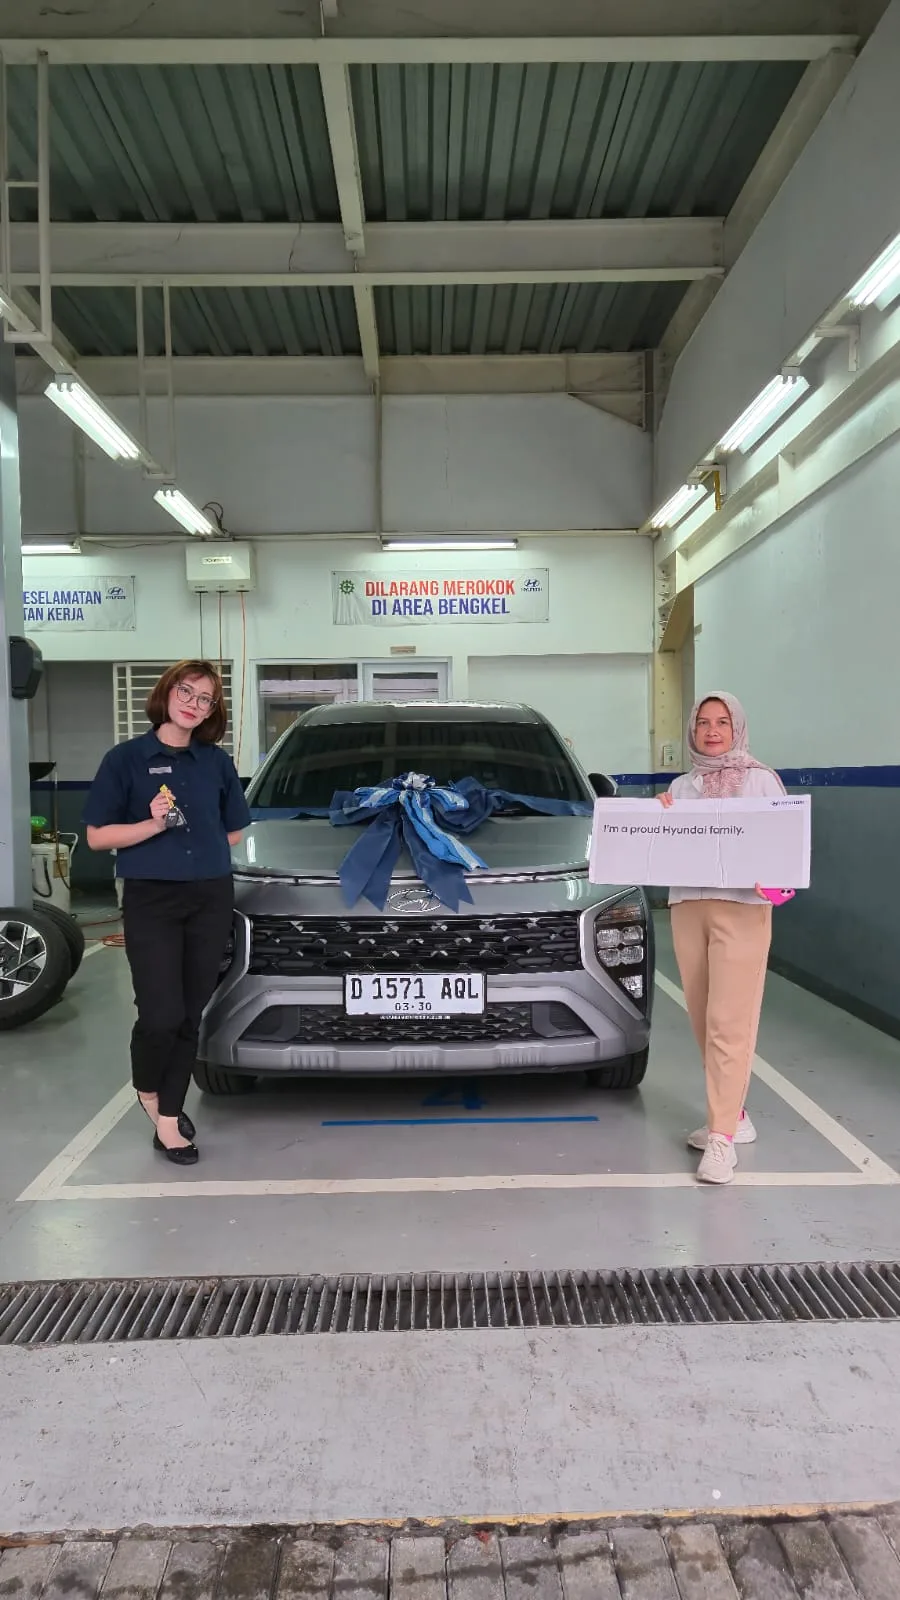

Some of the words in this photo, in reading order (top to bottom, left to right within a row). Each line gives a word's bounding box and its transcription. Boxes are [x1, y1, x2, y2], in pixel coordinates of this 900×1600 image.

[365, 580, 439, 597] DILARANG
[443, 579, 516, 596] MEROKOK
[47, 607, 85, 621] KERJA
[371, 598, 387, 616] DI
[392, 598, 434, 616] AREA
[438, 598, 510, 615] BENGKEL
[603, 824, 619, 833] I'm
[630, 825, 660, 836] proud
[662, 825, 707, 836] Hyundai
[709, 825, 744, 837] family.
[350, 977, 363, 1000] D
[372, 977, 426, 1000] 1571
[440, 977, 479, 1000] AQL
